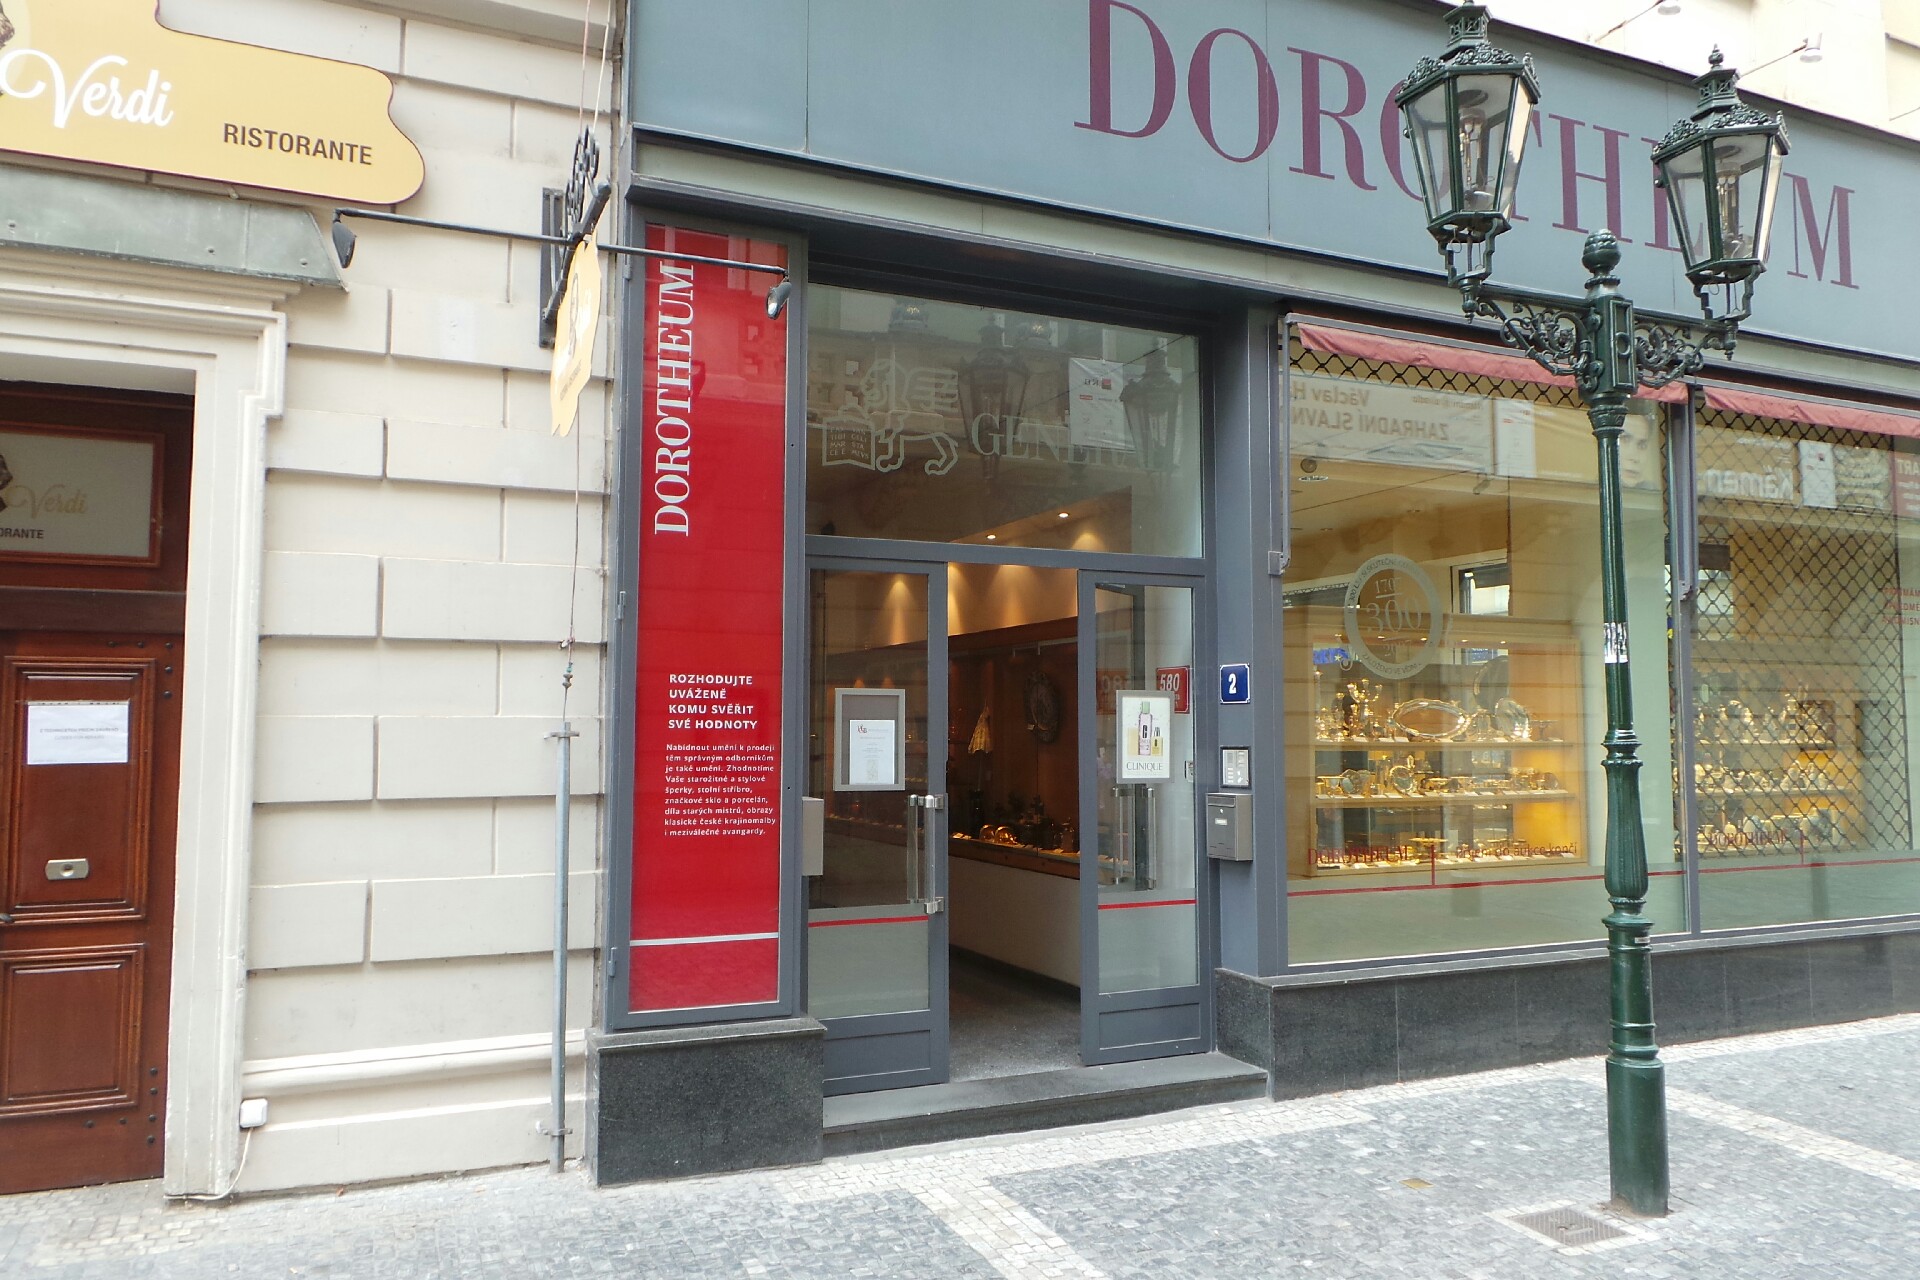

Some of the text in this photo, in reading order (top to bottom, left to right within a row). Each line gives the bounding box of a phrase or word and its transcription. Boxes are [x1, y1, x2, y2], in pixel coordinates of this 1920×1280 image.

[0, 49, 174, 129] Verdi
[223, 122, 373, 166] RISTORANTE
[1074, 0, 1859, 289] DOROHEM
[654, 261, 694, 537] DOROTHEUM
[5, 484, 89, 519] Verdi
[1366, 596, 1422, 633] 300
[670, 674, 753, 686] ROZHODUJTE
[1160, 673, 1180, 692] 580
[1228, 673, 1237, 694] 2
[669, 688, 727, 699] UVÁŽENĚ
[669, 704, 754, 714] KOMU SVĚŘIT
[668, 718, 758, 730] SVÉ HODNOTY
[746, 744, 775, 752] prodeji
[684, 754, 723, 763] správným
[665, 765, 673, 773] je
[1126, 762, 1164, 771] CLINIQUE
[687, 775, 728, 783] starožitné
[738, 775, 766, 783] stylové
[665, 786, 695, 794] šperky,
[722, 785, 753, 793] stříbro,
[731, 796, 768, 804] porcelán,
[664, 807, 774, 816] díla starých mistrů, obrazy
[664, 816, 776, 826] klasické české krajinomalby
[669, 828, 720, 836] meziválečné
[722, 828, 766, 836] avangardy.
[1548, 842, 1578, 854] končí
